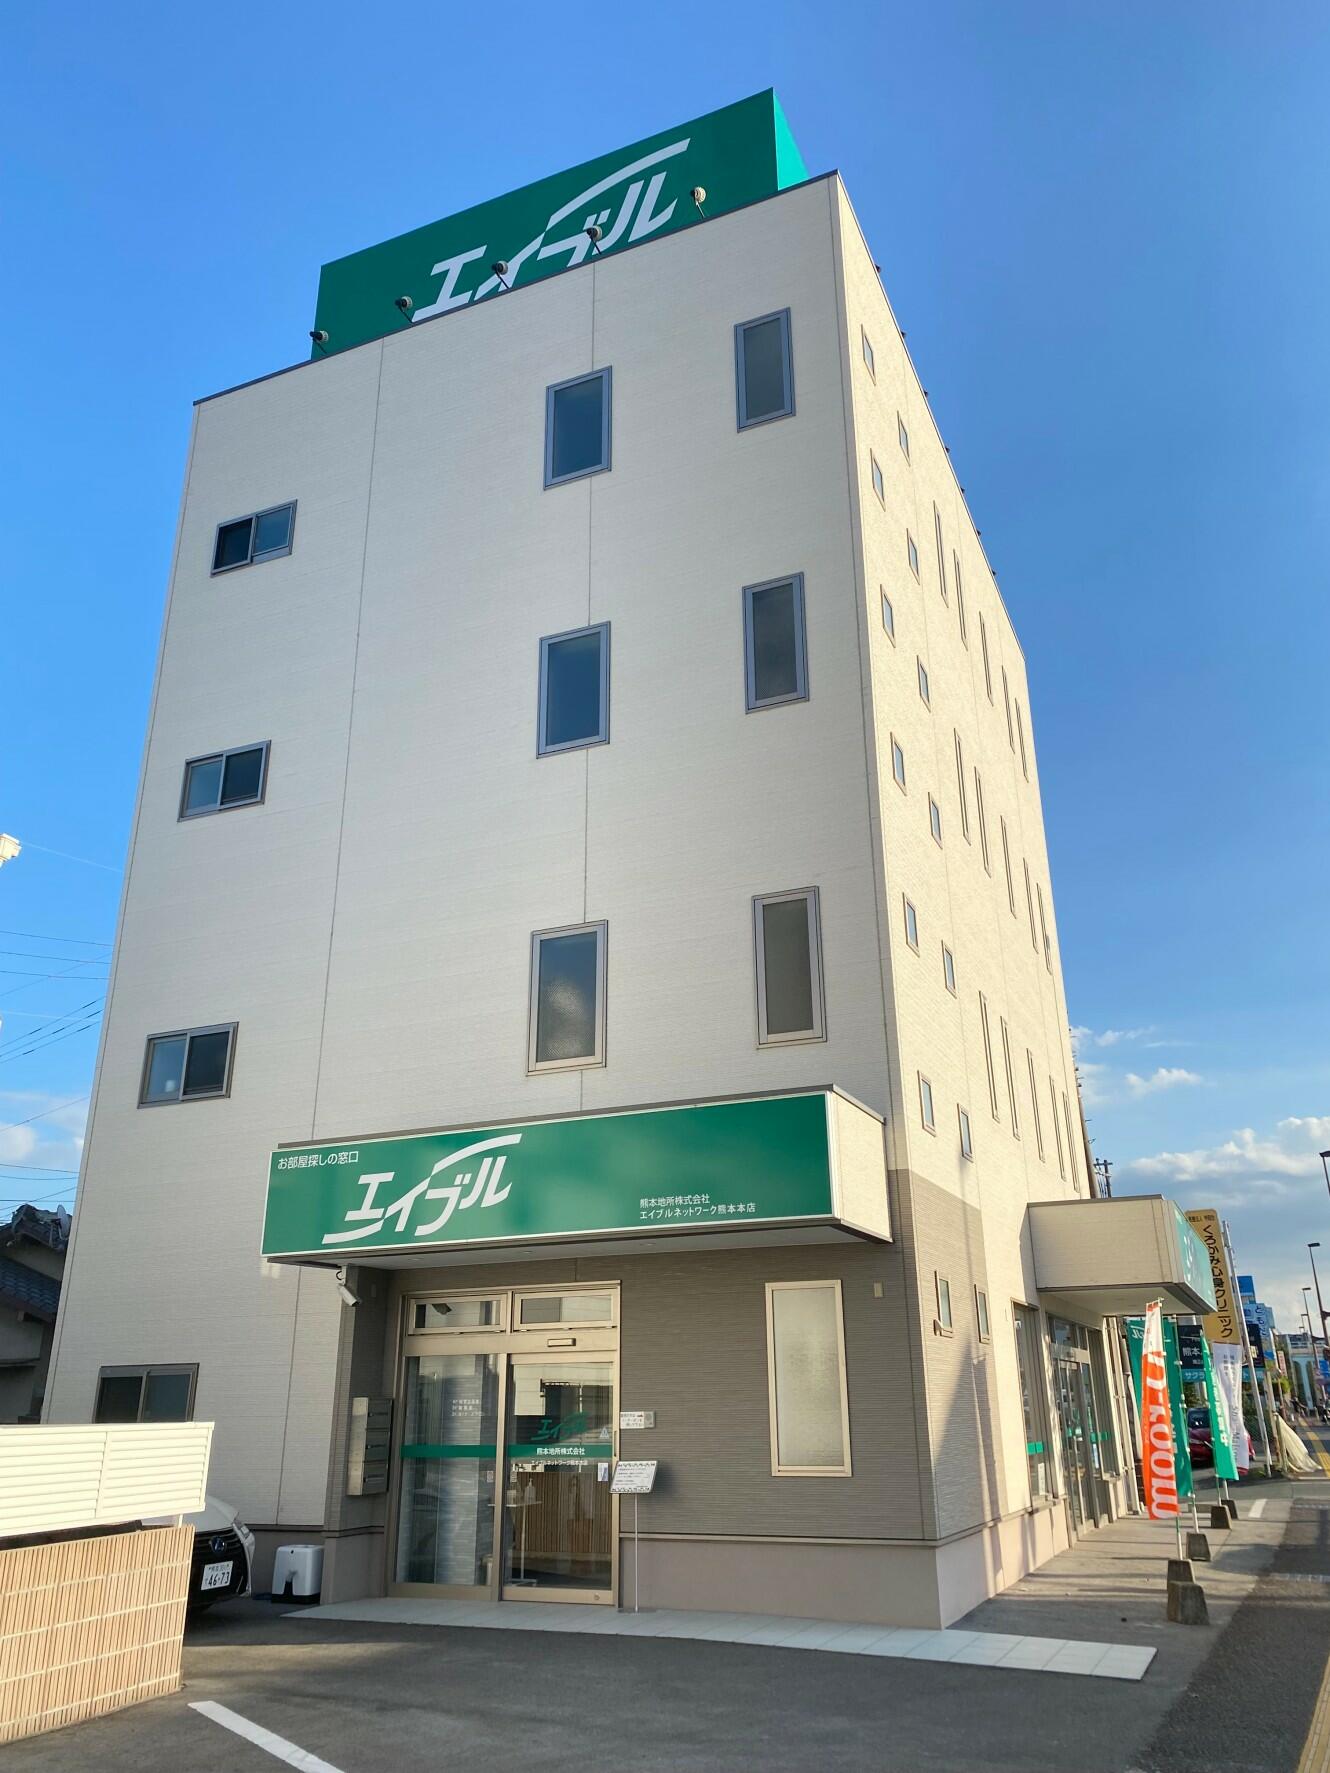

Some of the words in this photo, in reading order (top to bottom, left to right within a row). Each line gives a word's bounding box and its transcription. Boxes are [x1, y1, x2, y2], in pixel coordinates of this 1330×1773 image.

[412, 137, 691, 322] エイブル
[277, 1151, 359, 1169] お部屋探しの窓口
[321, 1133, 523, 1244] エイブル
[640, 1193, 711, 1208] 熊本地所株式会社
[640, 1202, 756, 1219] エイブルネットワーク熊本本店
[1182, 1346, 1203, 1357] 熊本
[536, 1447, 586, 1456] 熊本地所株式会社
